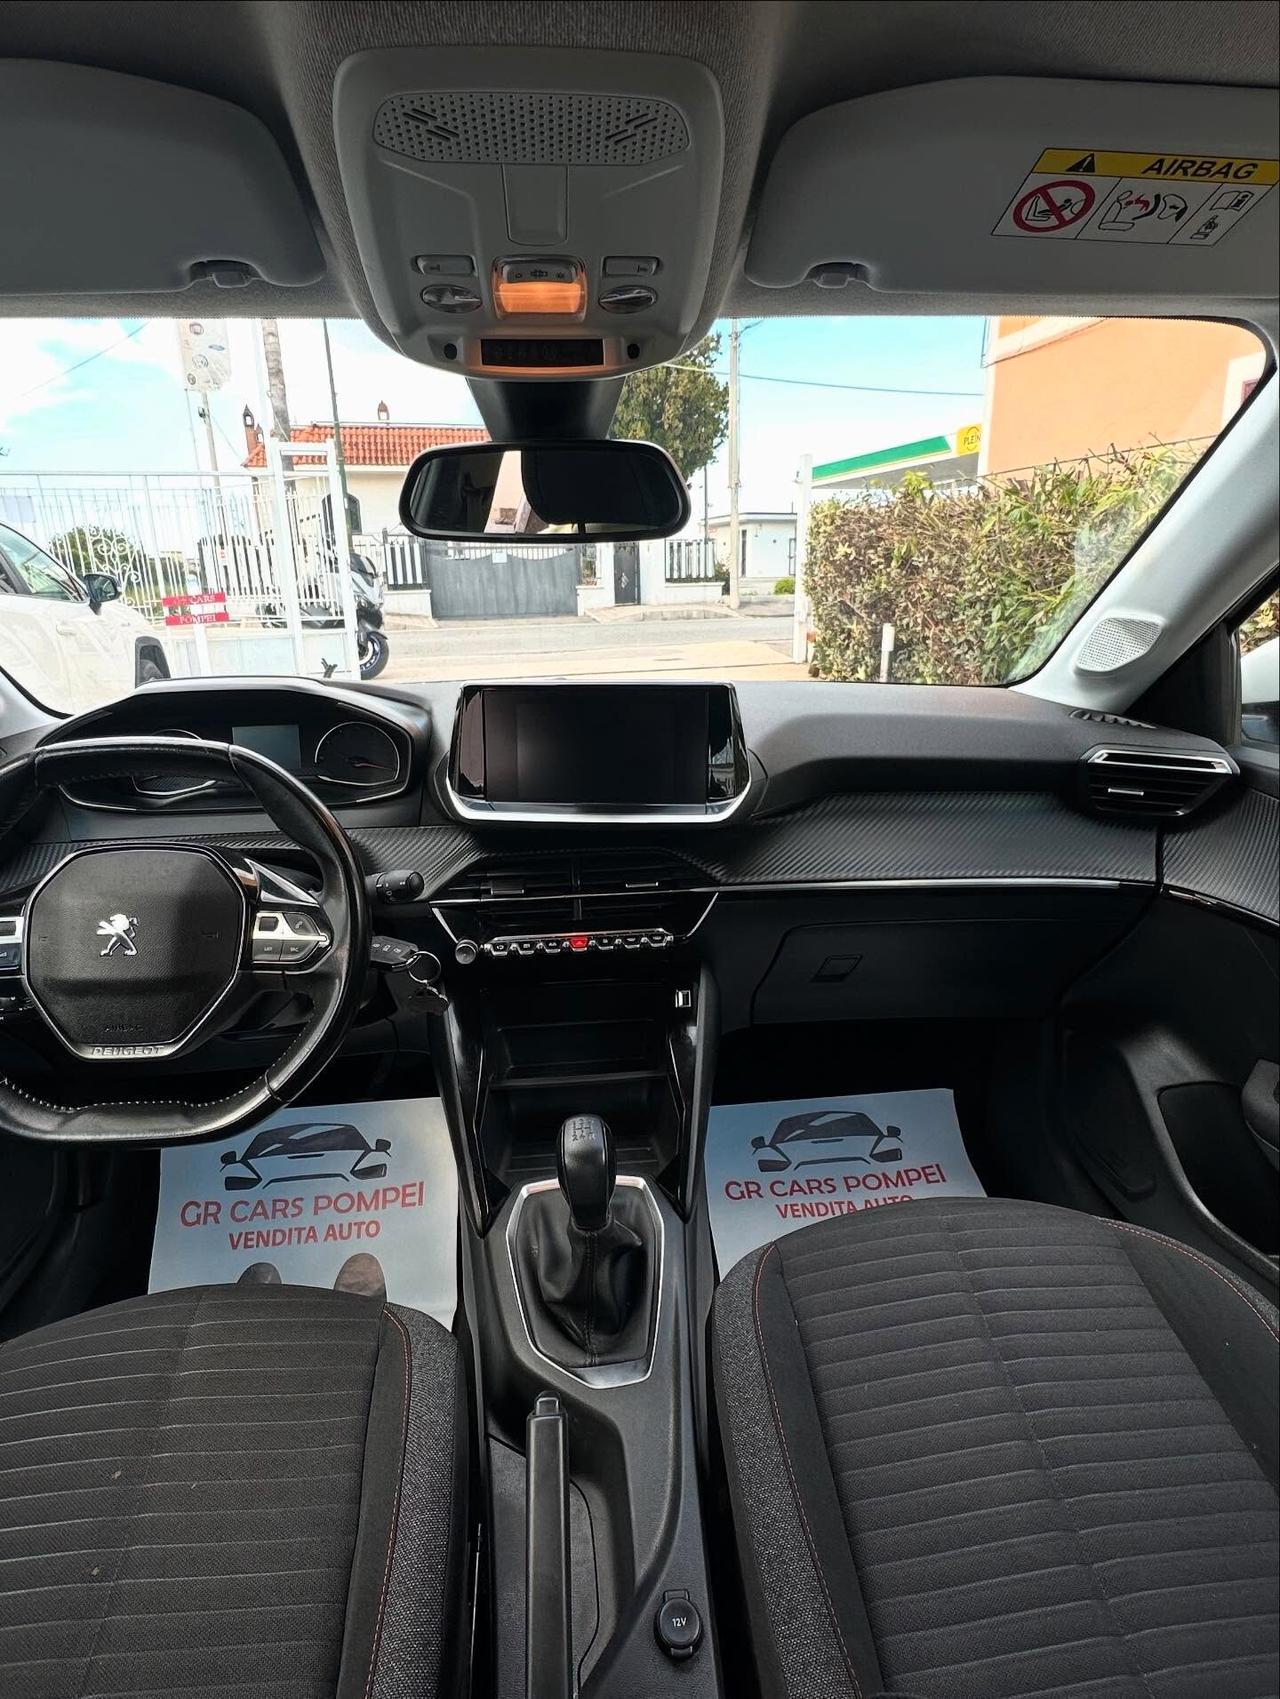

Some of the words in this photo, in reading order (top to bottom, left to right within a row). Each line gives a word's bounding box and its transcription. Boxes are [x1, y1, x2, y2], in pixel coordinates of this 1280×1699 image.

[1141, 158, 1259, 180] AIRBAG
[180, 613, 216, 624] POMPEI
[91, 1045, 165, 1056] PEUGEOT
[725, 1180, 764, 1201] GR
[769, 1177, 837, 1197] CARS
[844, 1163, 947, 1193] POMPEI
[180, 1200, 222, 1227] GR
[229, 1196, 304, 1223] CARS
[313, 1181, 425, 1216] POMPEI
[775, 1199, 858, 1219] VENDITA
[228, 1225, 318, 1250] VENDITA
[323, 1220, 381, 1242] AUTO
[672, 1616, 687, 1627] 12V
